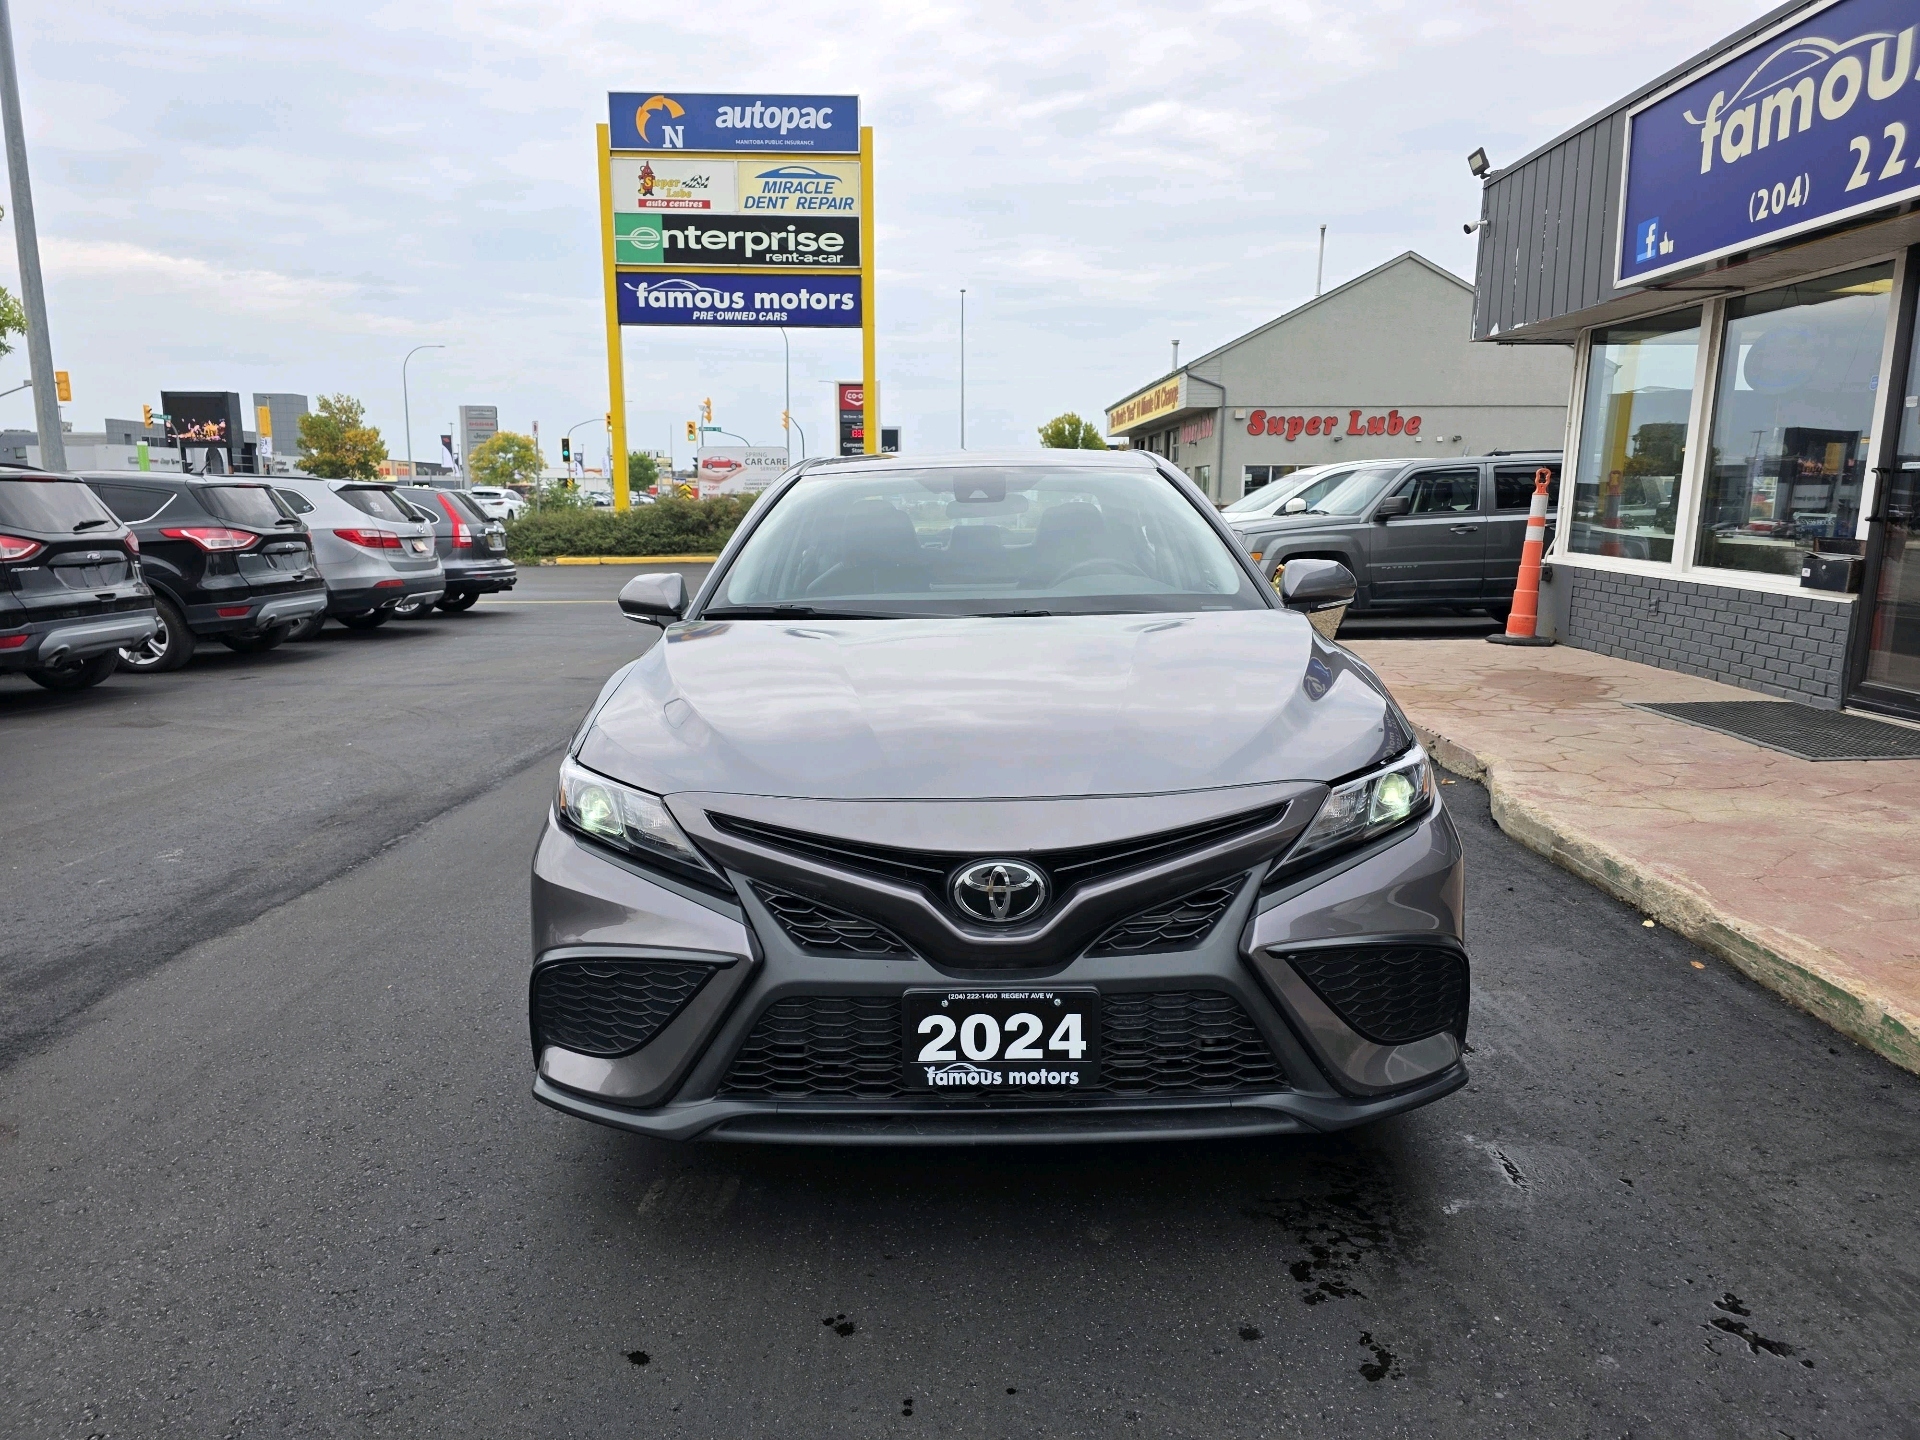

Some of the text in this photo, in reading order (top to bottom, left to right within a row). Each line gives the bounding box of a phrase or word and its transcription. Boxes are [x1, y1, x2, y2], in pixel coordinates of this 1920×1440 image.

[1700, 24, 1920, 175] famou
[715, 100, 833, 135] autopac
[661, 125, 685, 148] N
[1749, 121, 1920, 223] (204) 22
[644, 176, 681, 189] Super
[762, 180, 835, 194] MIRACLE
[666, 188, 692, 198] Lube
[744, 195, 855, 210] DENT REPAIR
[669, 200, 702, 208] centres
[628, 224, 845, 258] enterprise
[765, 252, 844, 263] rent-a-car
[636, 281, 855, 310] famous motors
[692, 311, 788, 321] PRE-OWNED CARS
[1247, 409, 1422, 441] Super Lube
[744, 458, 788, 466] CAR CARE
[917, 1012, 1087, 1062] 2024
[926, 1066, 1079, 1086] famous motors
